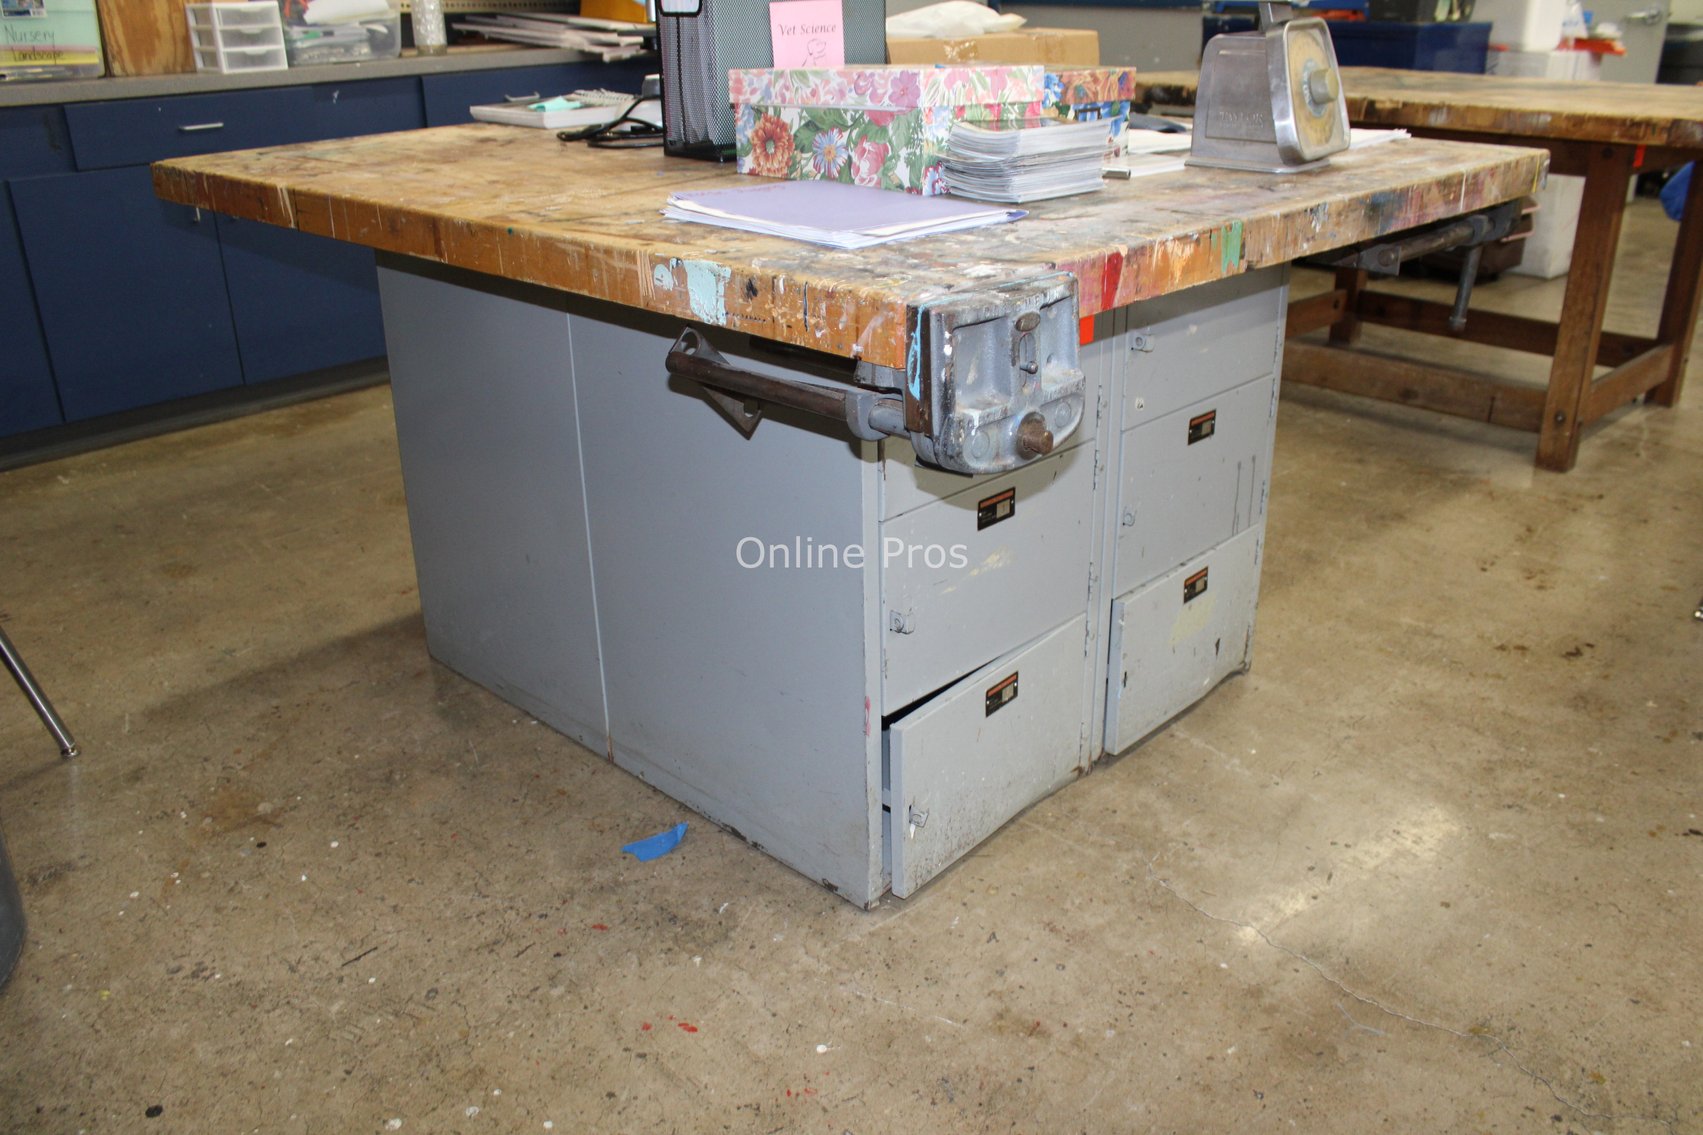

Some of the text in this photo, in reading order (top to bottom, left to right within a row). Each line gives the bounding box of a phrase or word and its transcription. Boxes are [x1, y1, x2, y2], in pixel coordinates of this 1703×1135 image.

[4, 24, 56, 49] Nursery
[778, 23, 837, 36] Vet Science
